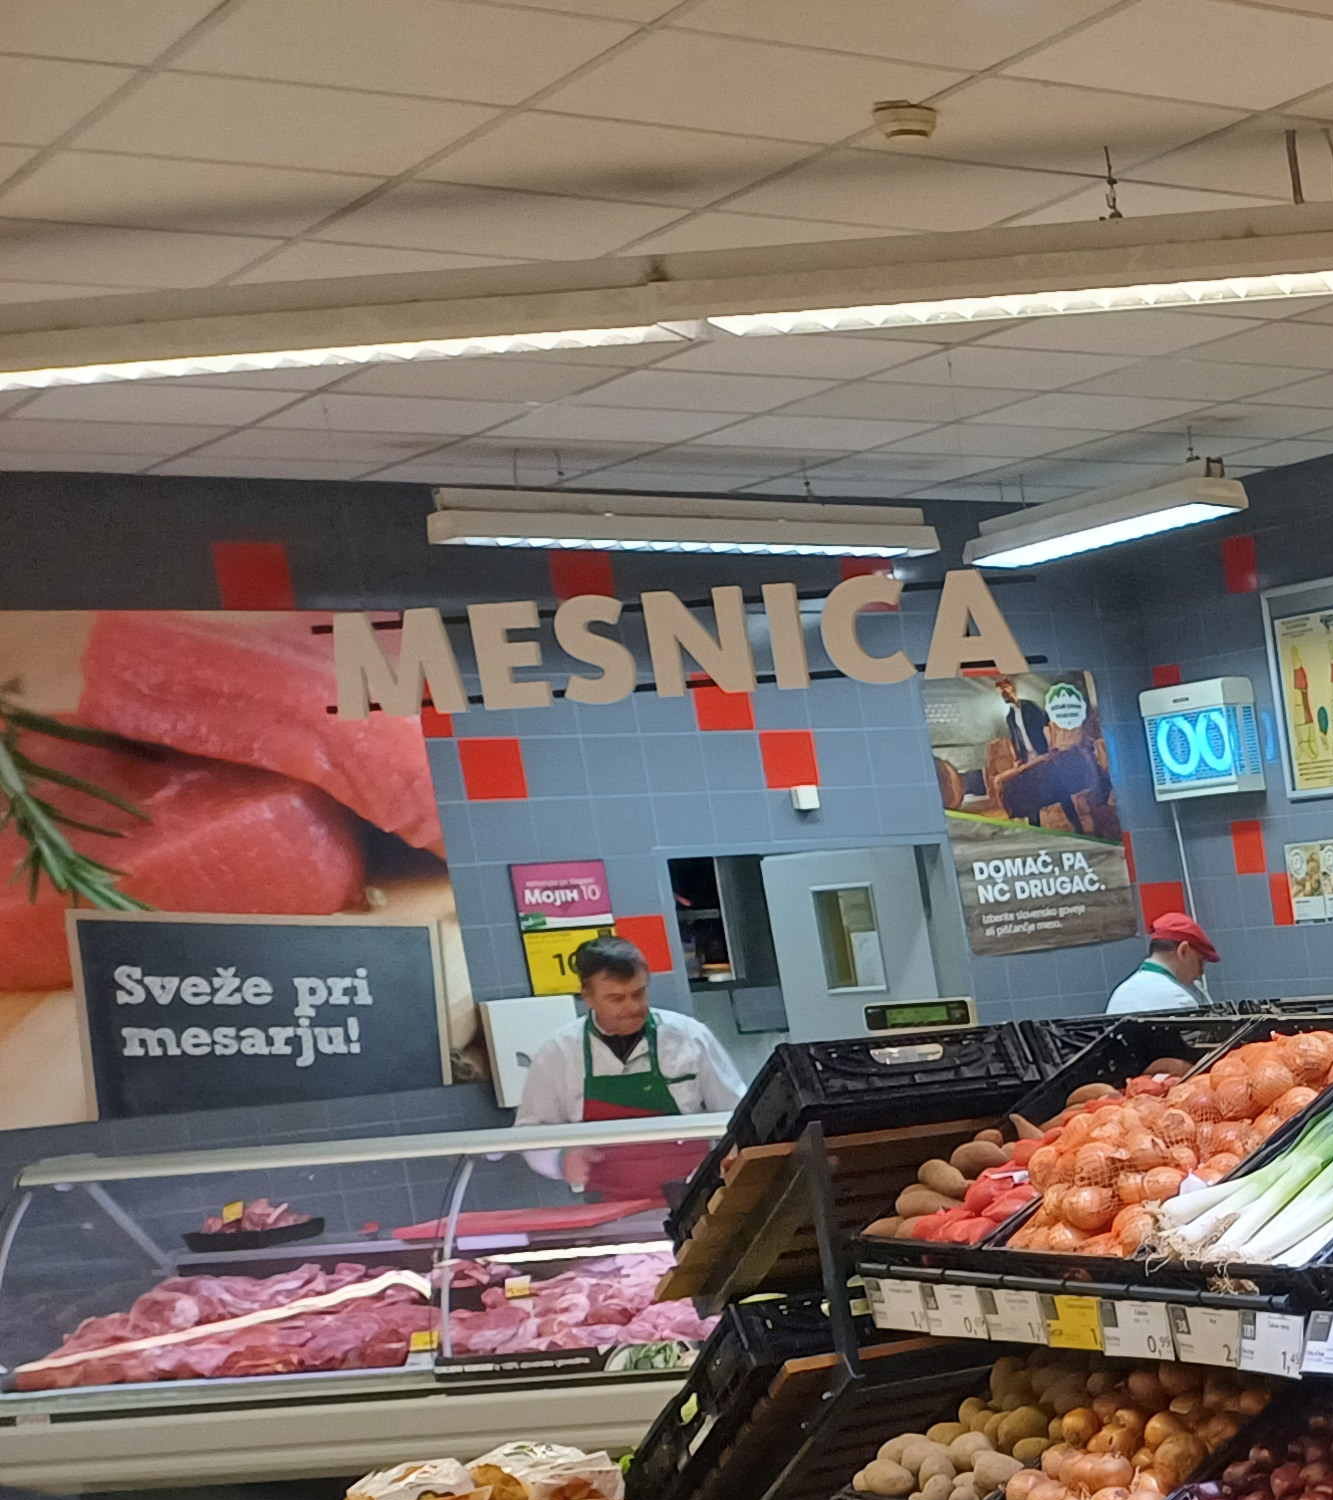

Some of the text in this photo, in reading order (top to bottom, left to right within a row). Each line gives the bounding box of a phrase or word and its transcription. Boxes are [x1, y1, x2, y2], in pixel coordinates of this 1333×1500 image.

[333, 569, 1031, 721] MESNICA
[973, 850, 1090, 881] DOMAČ, PA
[977, 867, 1106, 904] NČ DRUGAČ.
[114, 965, 374, 1018] Sveže pri
[121, 1016, 362, 1068] mesarju!
